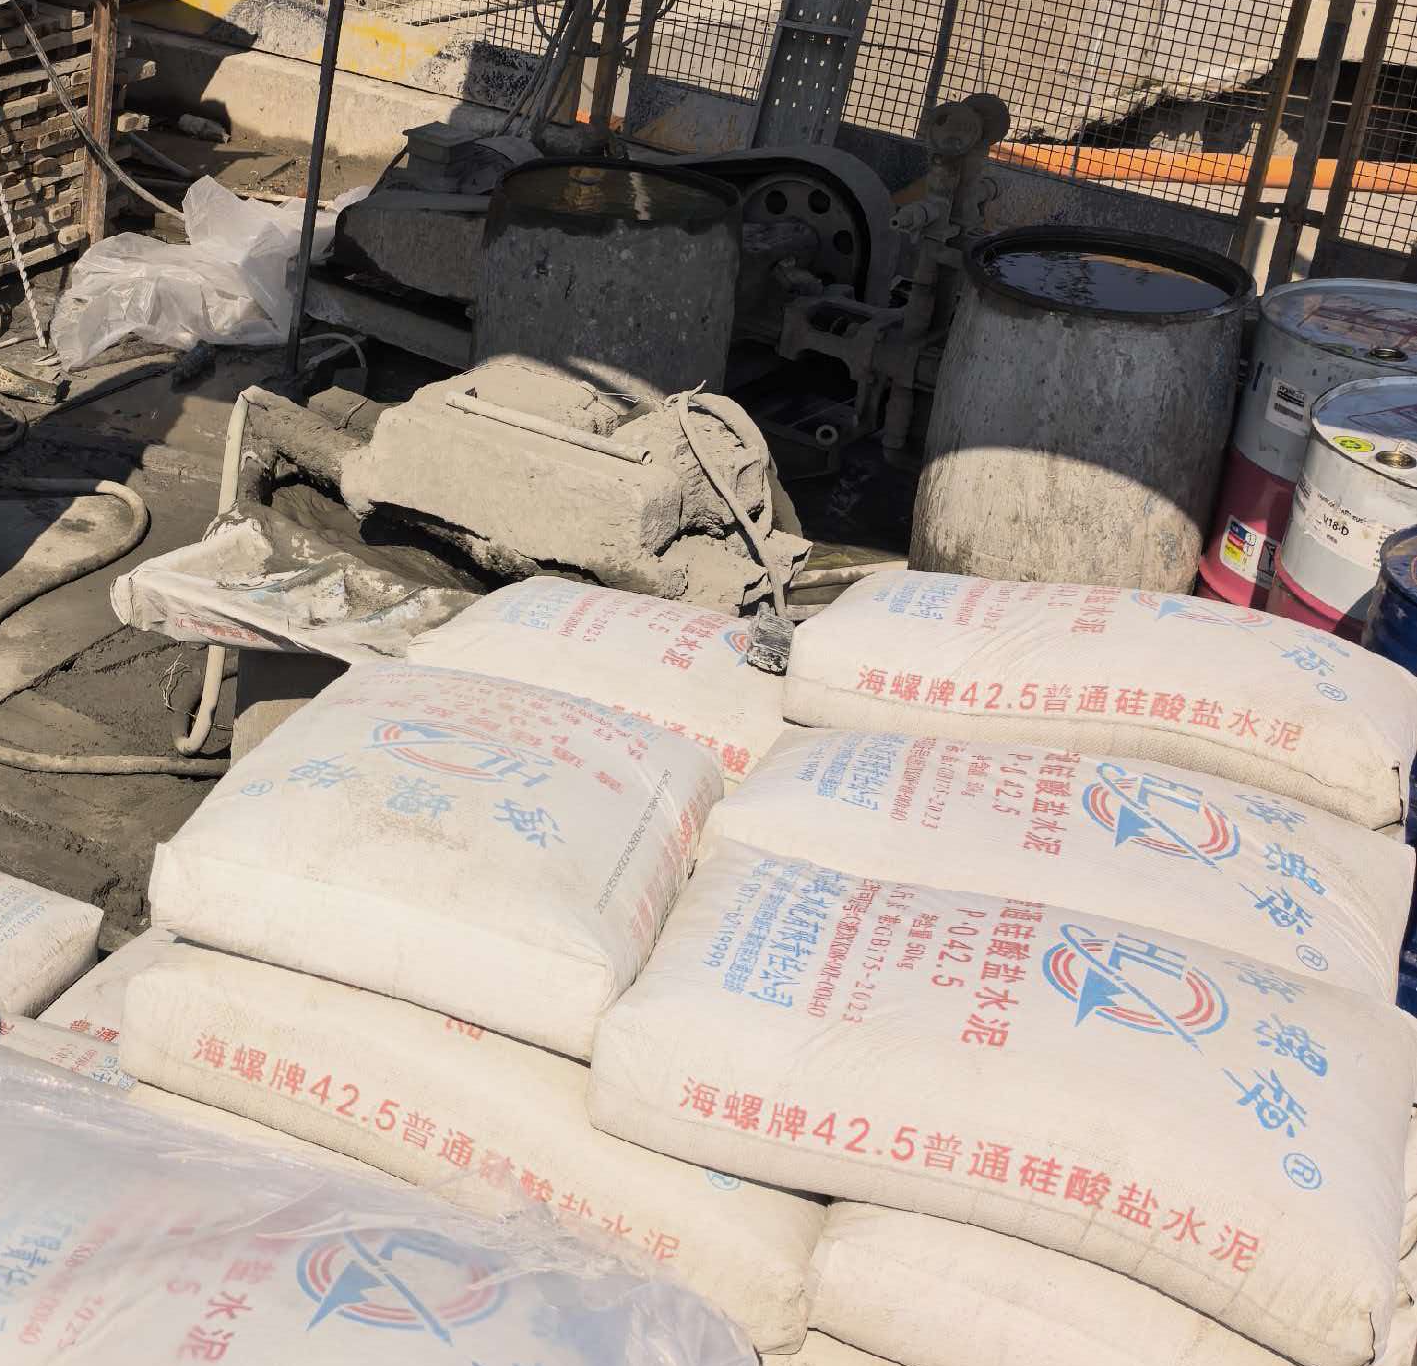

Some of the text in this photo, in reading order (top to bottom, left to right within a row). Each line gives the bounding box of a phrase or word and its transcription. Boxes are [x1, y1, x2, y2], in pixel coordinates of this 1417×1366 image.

[855, 664, 1304, 754] 海螺牌42.5普通硅酸盐水泥
[1132, 771, 1204, 812] HL
[1108, 930, 1193, 986] HL
[678, 1074, 1265, 1277] 海螺牌42.5普通硅酸盐水泥
